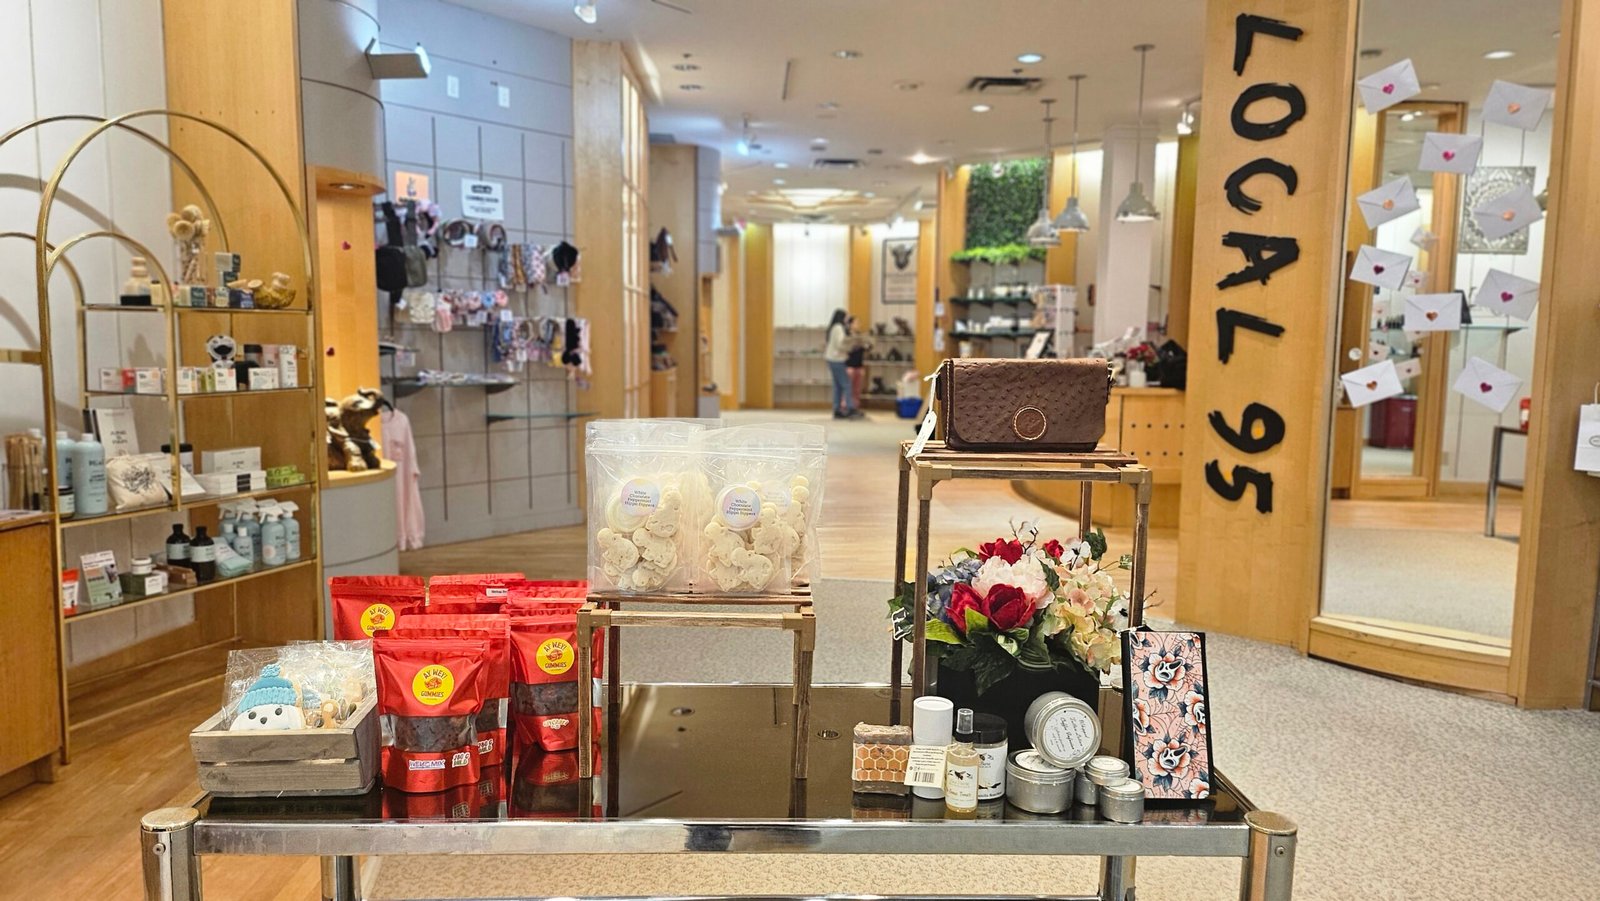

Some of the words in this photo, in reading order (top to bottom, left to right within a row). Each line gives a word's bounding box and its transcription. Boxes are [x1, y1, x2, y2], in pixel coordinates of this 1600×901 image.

[1216, 12, 1308, 365] LOCAL
[1204, 402, 1287, 516] 95
[369, 608, 376, 616] AY
[543, 644, 551, 652] AY
[552, 641, 568, 651] WEY!
[544, 661, 567, 669] GUMMIES
[423, 669, 431, 680] AY
[432, 668, 448, 680] WEY!
[420, 690, 444, 698] GUMMIES
